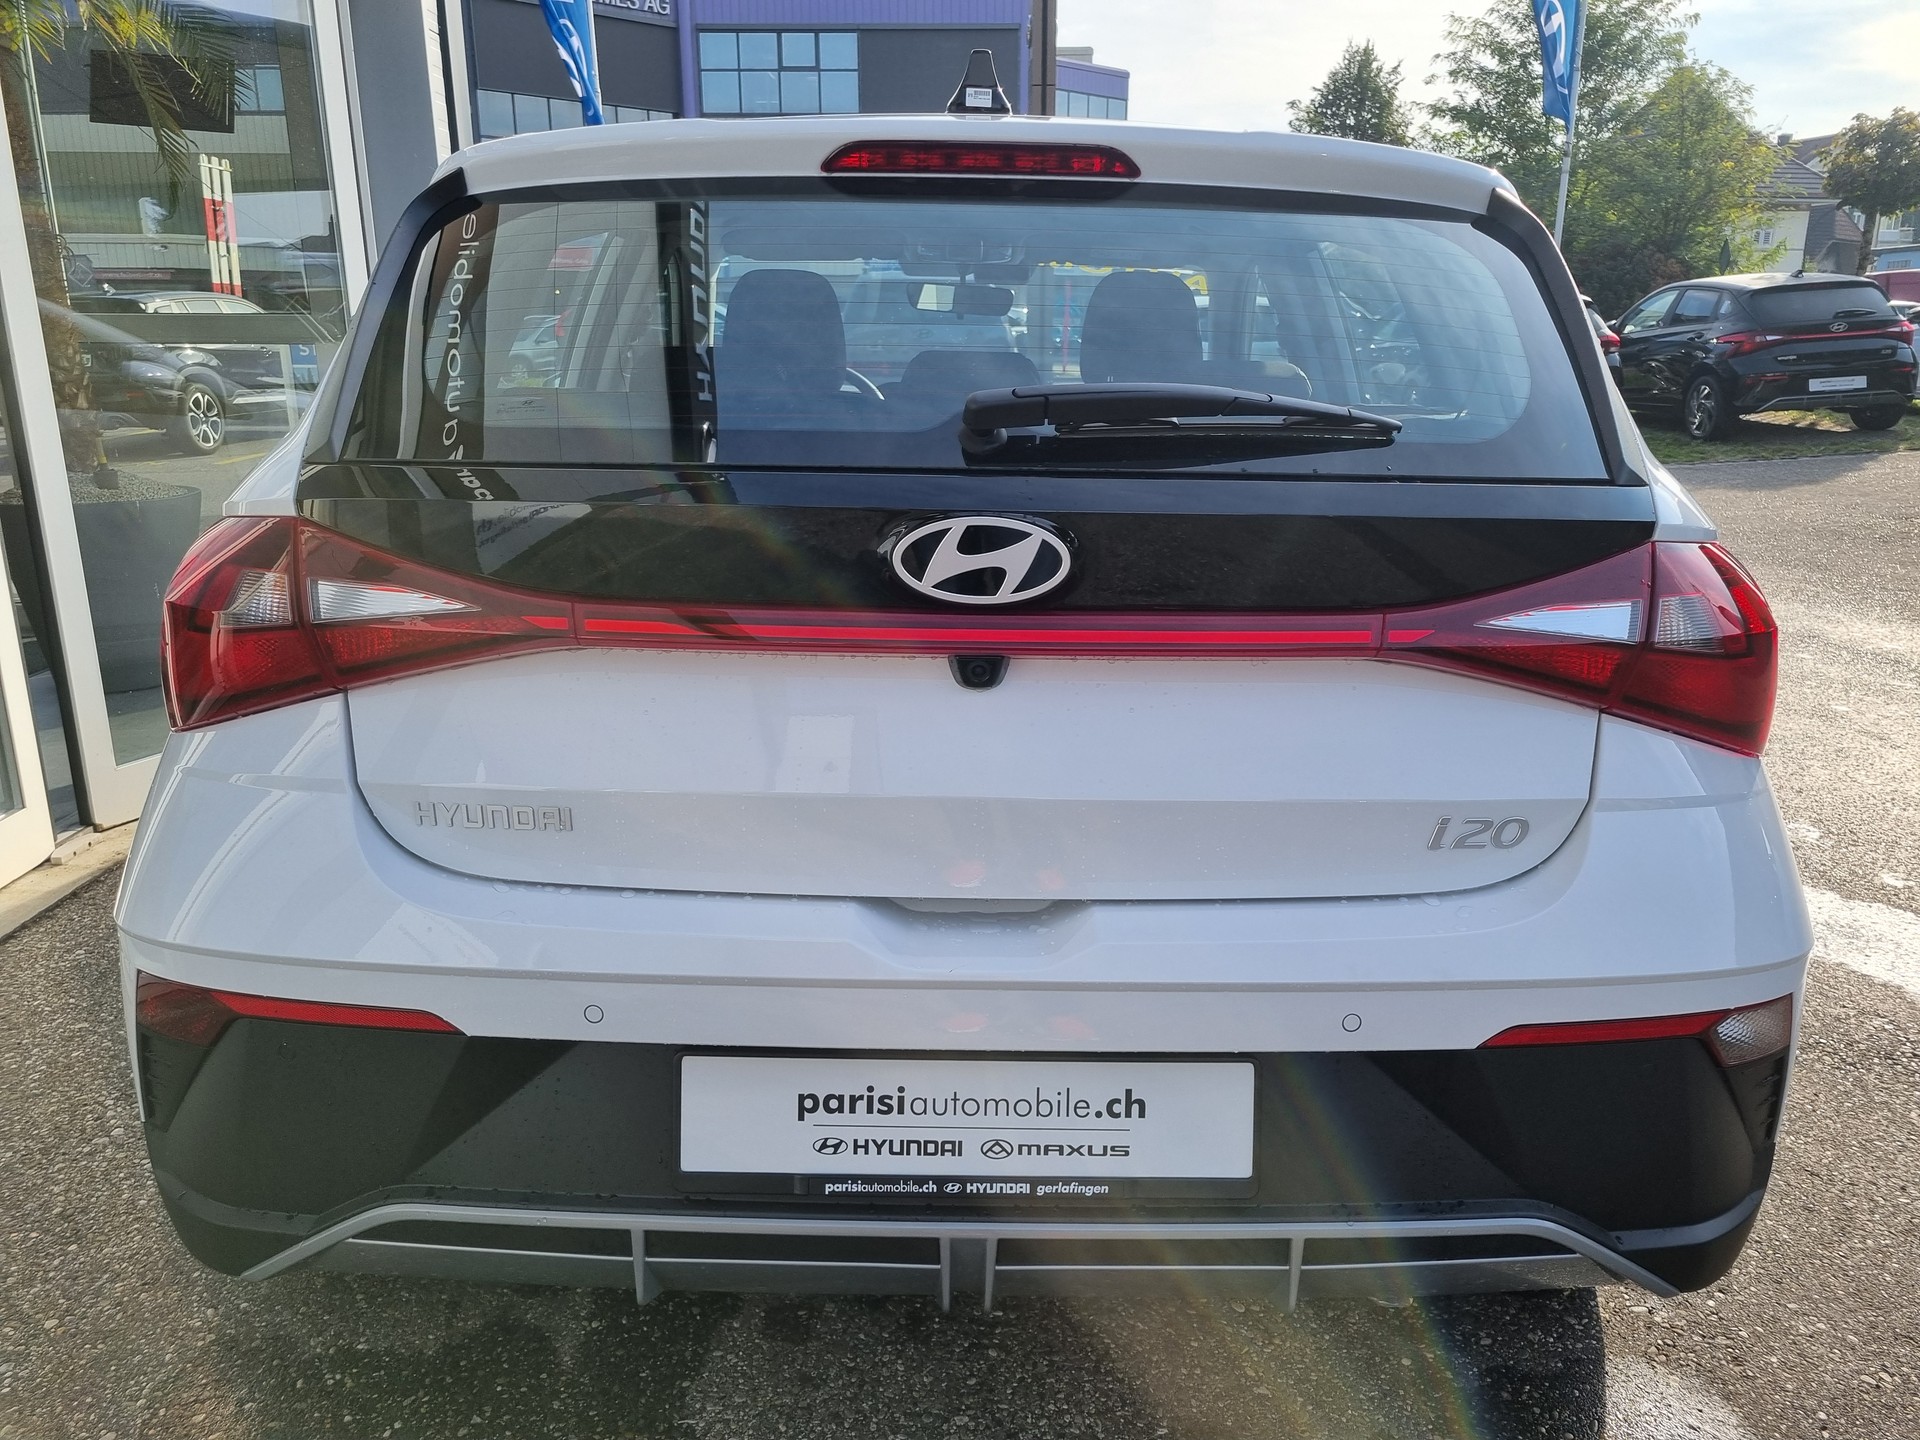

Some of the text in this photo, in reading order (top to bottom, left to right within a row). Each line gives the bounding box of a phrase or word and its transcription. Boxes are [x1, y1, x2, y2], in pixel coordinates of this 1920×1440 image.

[644, 0, 671, 14] AG
[415, 801, 573, 832] HYUNDAI
[1427, 815, 1530, 850] i20
[797, 1084, 1146, 1121] parisiautomobile.ch
[853, 1138, 963, 1157] HYUNDAI
[824, 1180, 1109, 1197] parisiautomobile.ch HYUNDAI gerlafingen
